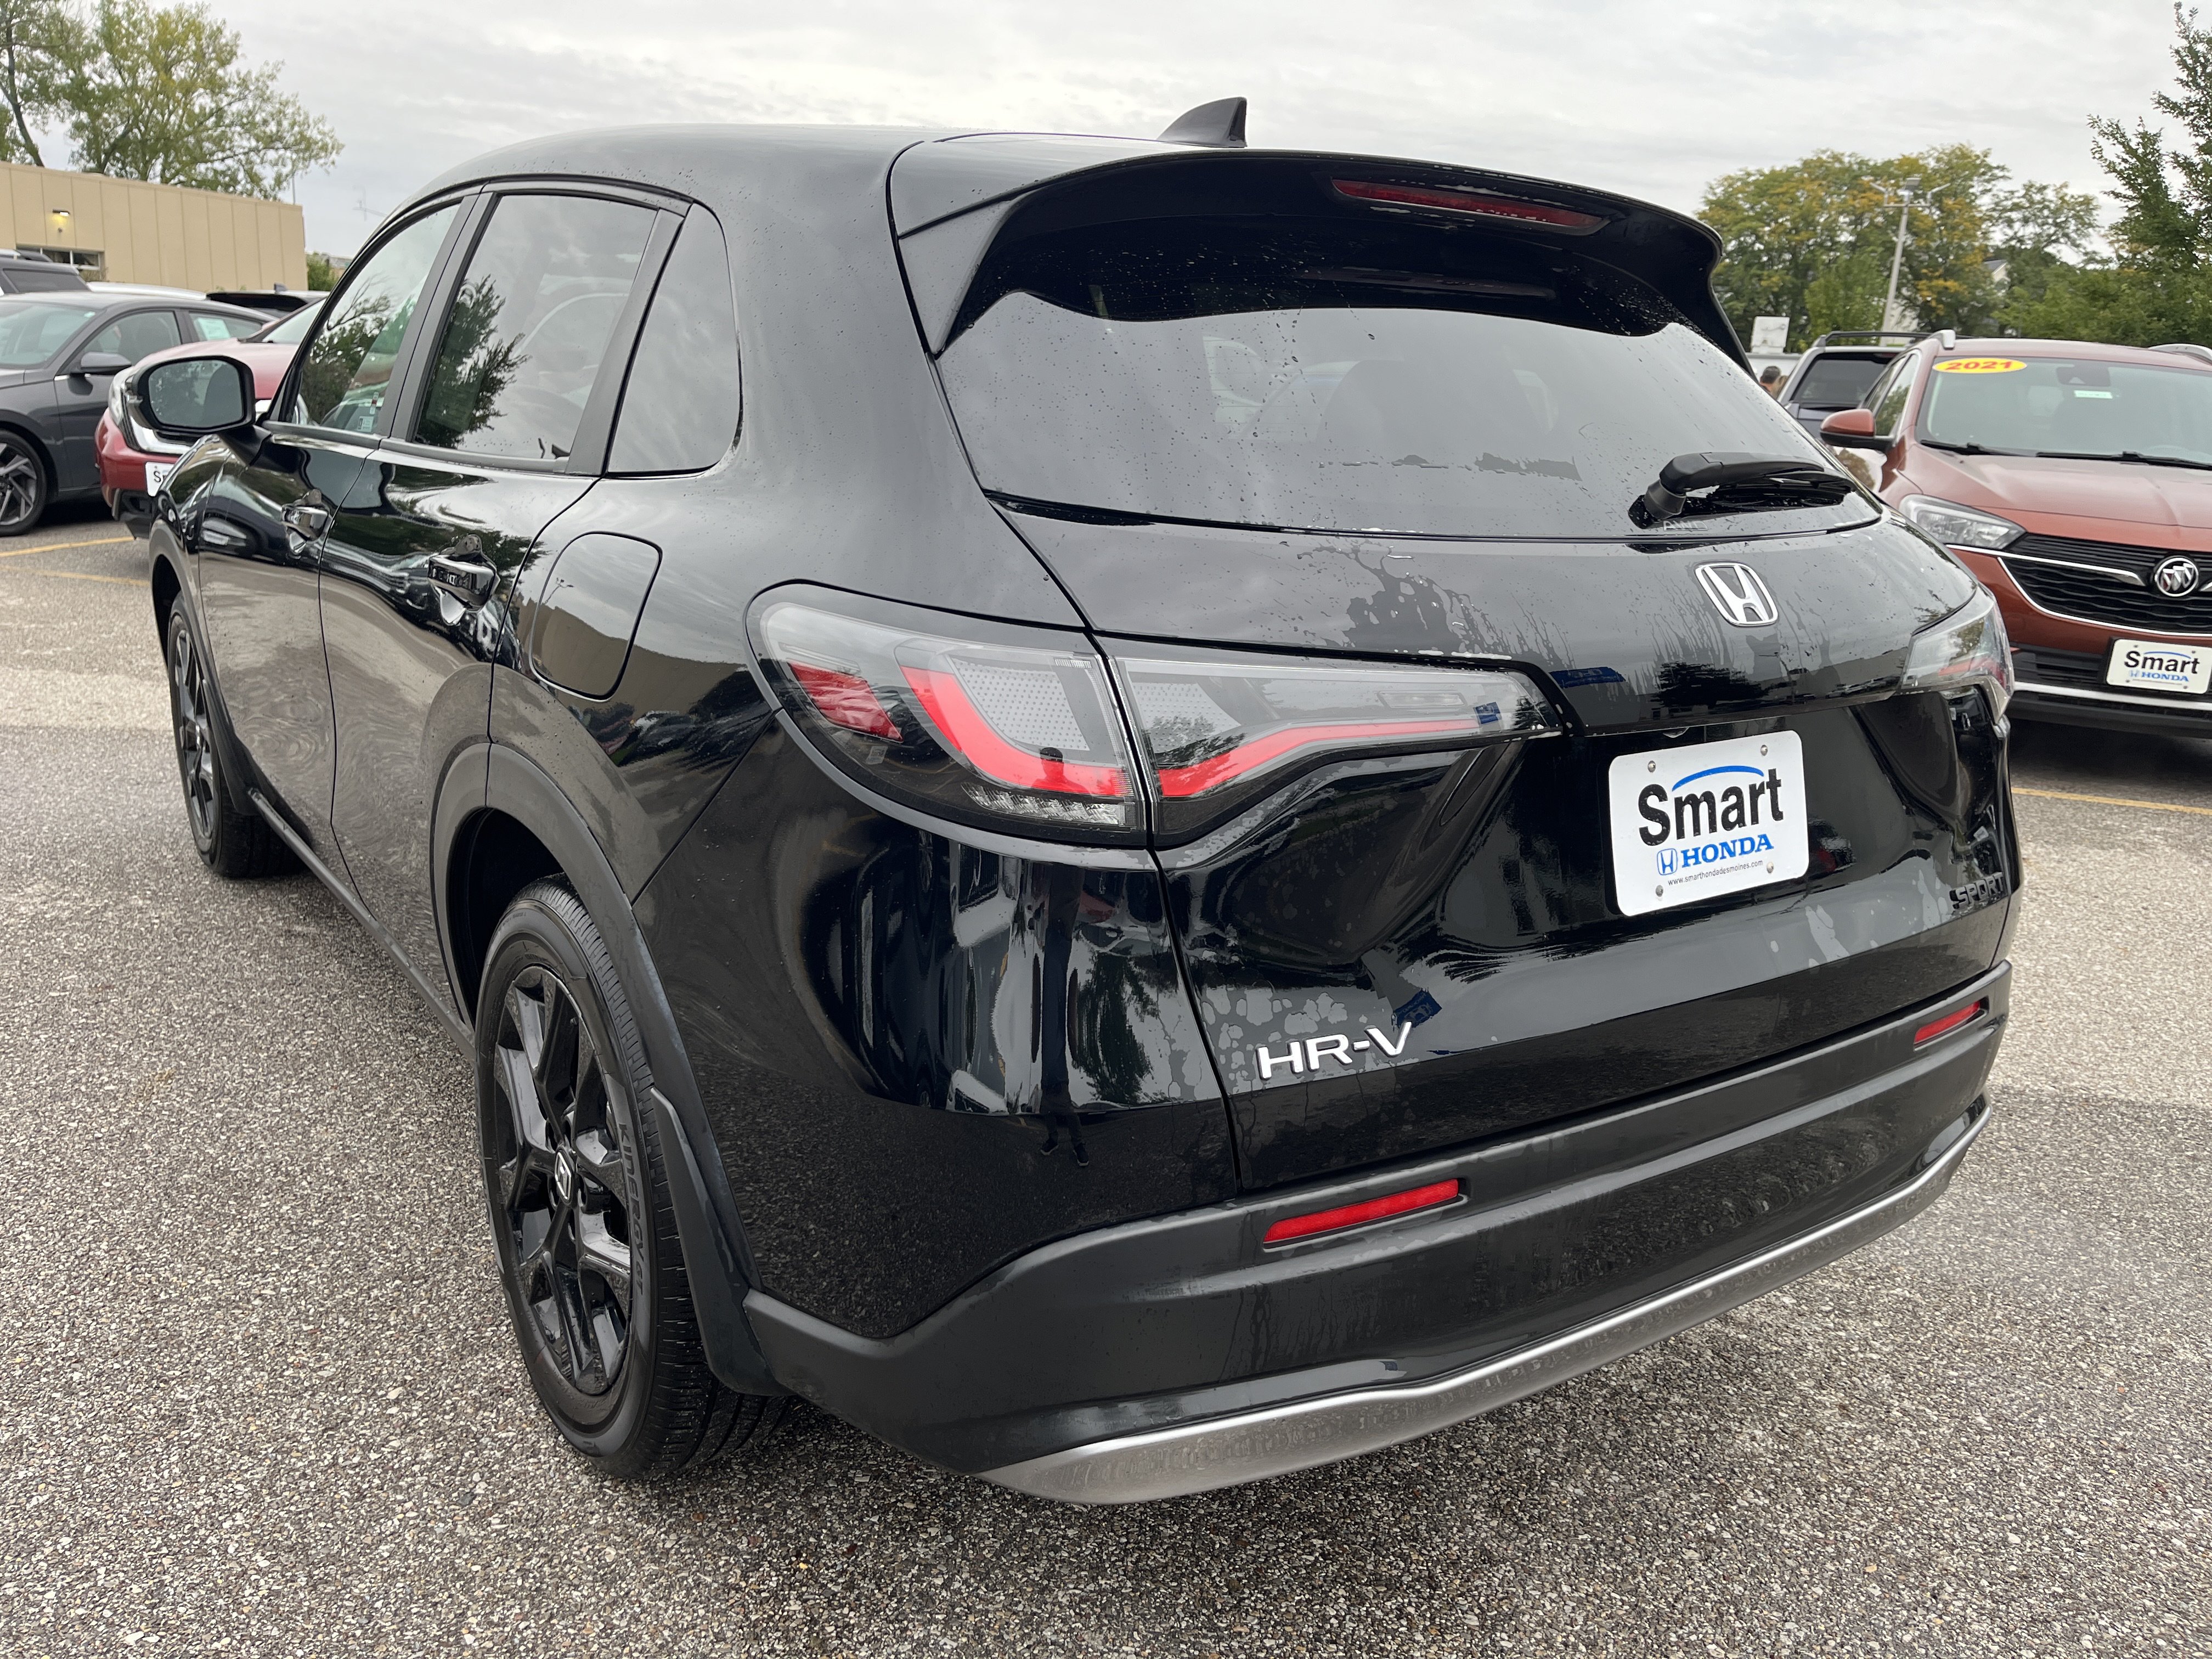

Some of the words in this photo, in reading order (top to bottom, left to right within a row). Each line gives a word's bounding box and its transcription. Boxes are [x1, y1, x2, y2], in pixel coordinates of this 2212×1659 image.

[1945, 361, 2013, 371] 2021
[2124, 651, 2200, 674] Smart
[2141, 672, 2190, 682] HONDA
[1638, 768, 1784, 846] Smart
[1680, 833, 1774, 868] HONDA
[1667, 859, 1763, 886] www.smarthondadesmoines.com
[1950, 871, 2004, 909] SPORT
[1255, 1021, 1412, 1080] HR-V
